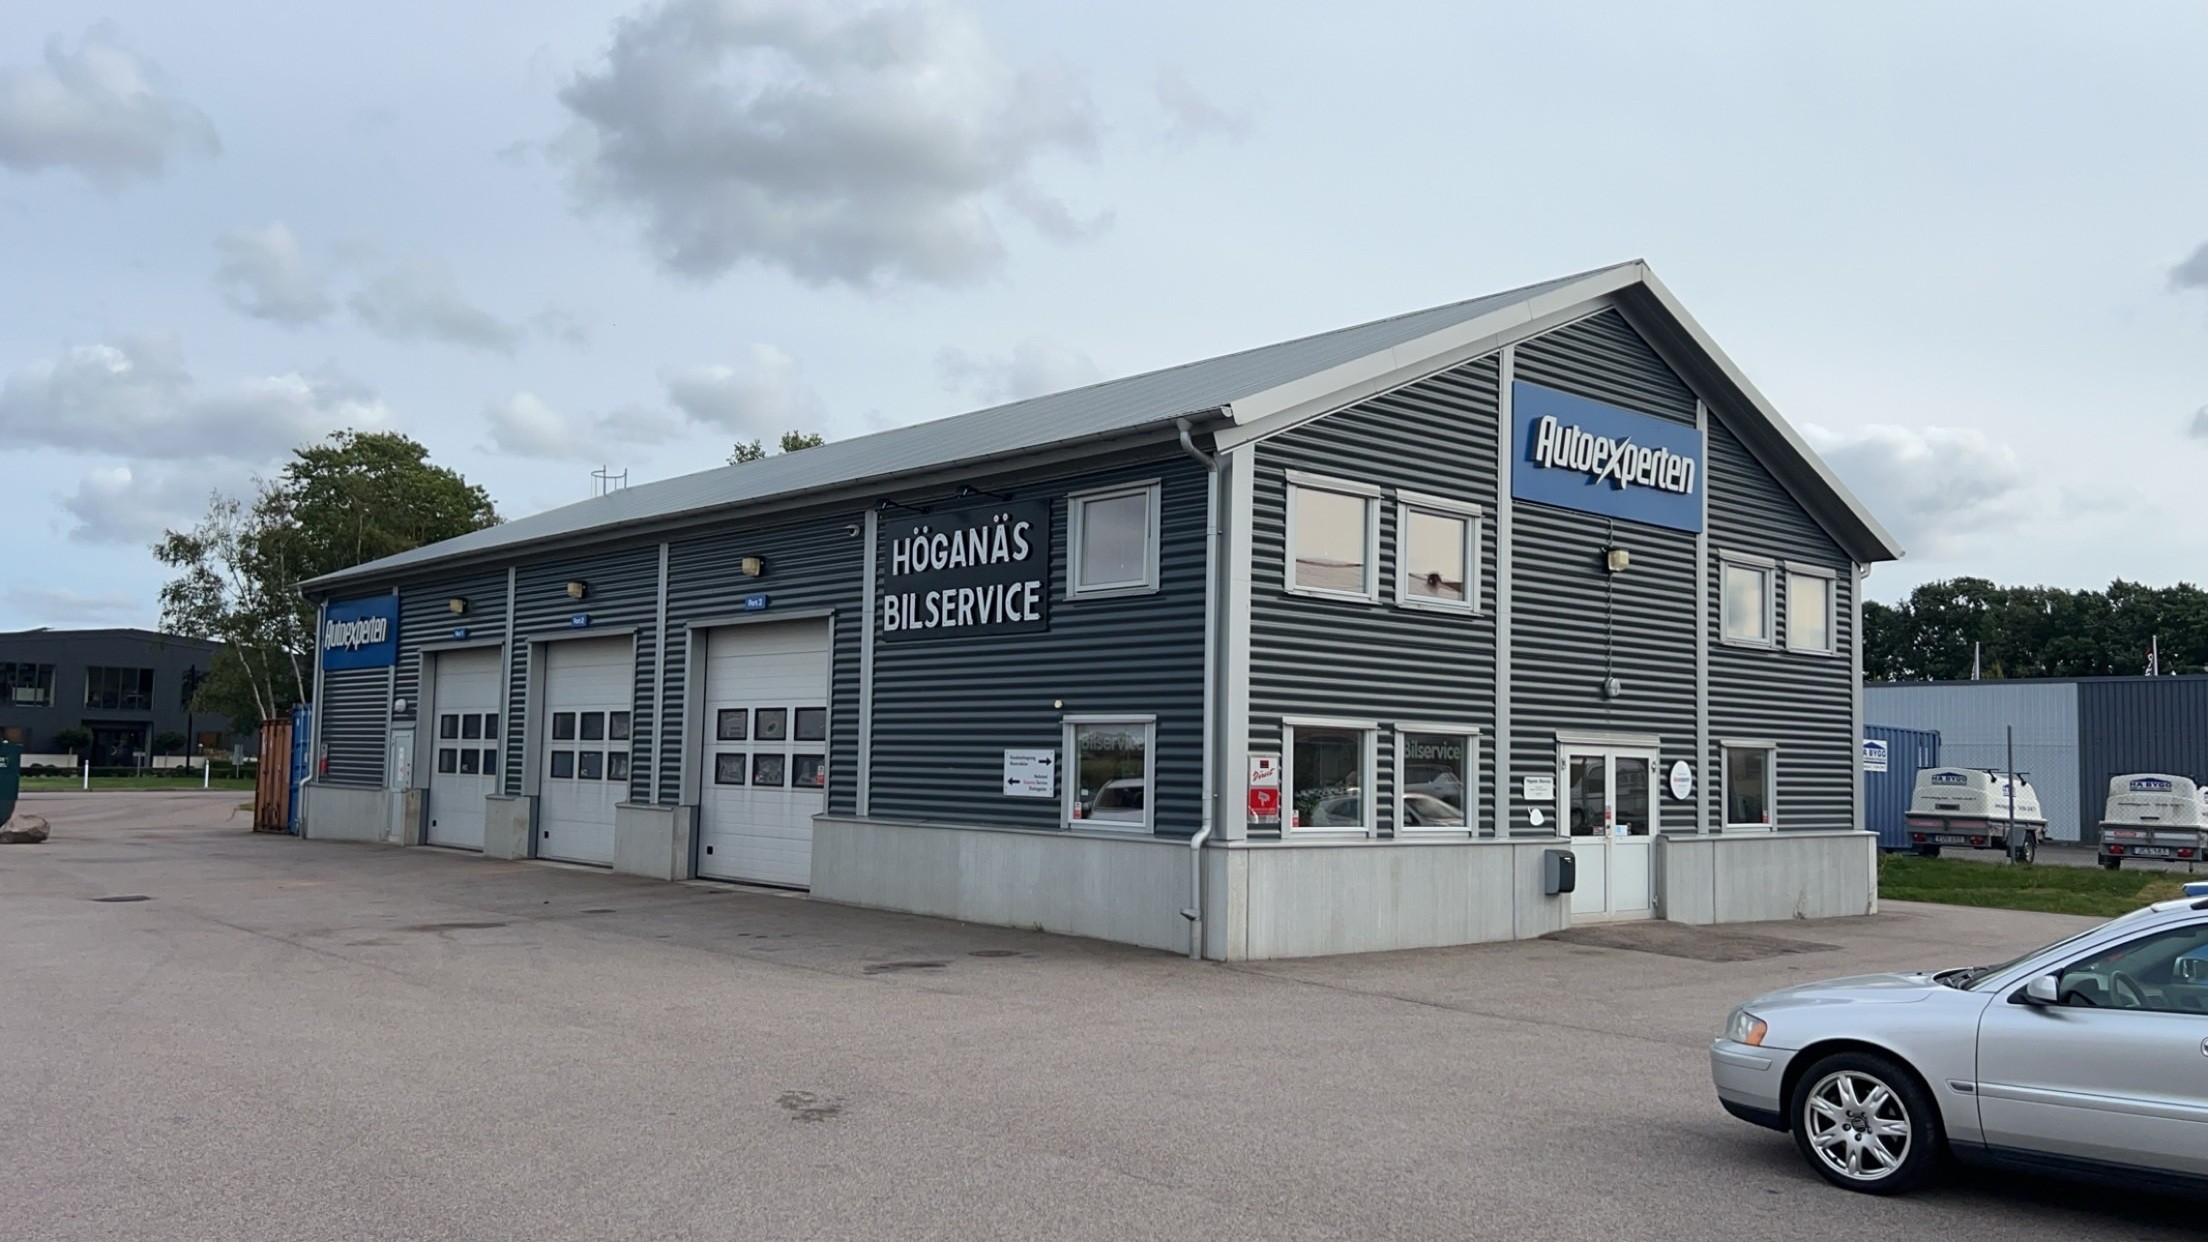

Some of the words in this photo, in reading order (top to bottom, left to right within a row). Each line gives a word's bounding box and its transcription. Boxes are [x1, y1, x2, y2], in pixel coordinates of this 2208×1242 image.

[1536, 415, 1696, 494] Autoexperten
[892, 513, 1030, 576] HÖGANÄS
[884, 580, 1041, 631] BILSERVICE
[324, 616, 387, 652] Autoexperten
[1404, 740, 1461, 759] Bilservice
[1869, 750, 1886, 758] BYGG
